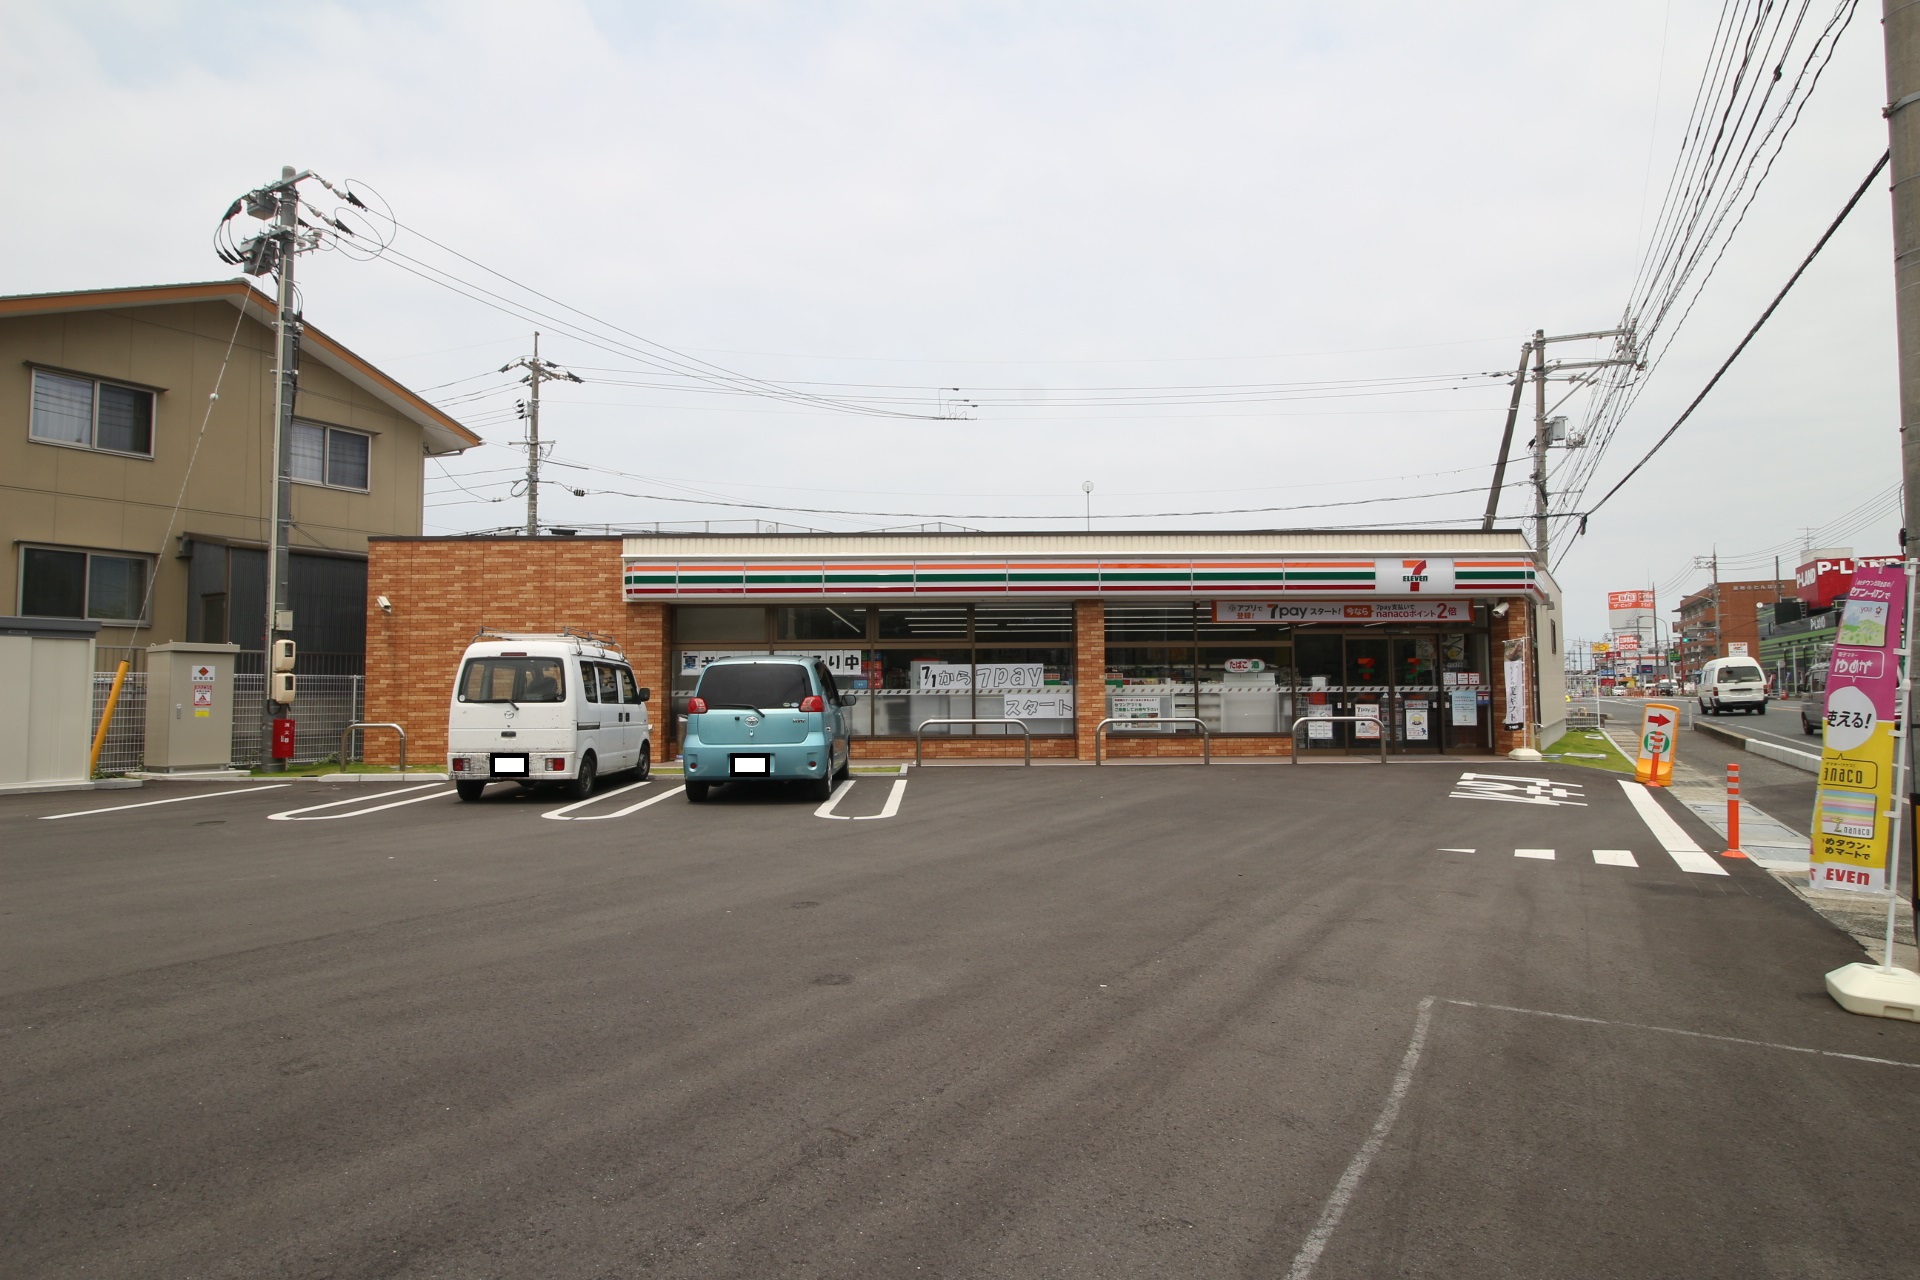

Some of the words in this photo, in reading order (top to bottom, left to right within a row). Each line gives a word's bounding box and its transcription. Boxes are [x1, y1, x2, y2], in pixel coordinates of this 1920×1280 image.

[1267, 604, 1308, 619] 7pay
[1346, 607, 1369, 616] 今なら
[1376, 610, 1436, 618] nanacoポイント
[1230, 661, 1248, 669] たばこ
[1006, 699, 1073, 717] スタート
[1844, 826, 1870, 836] nanaco
